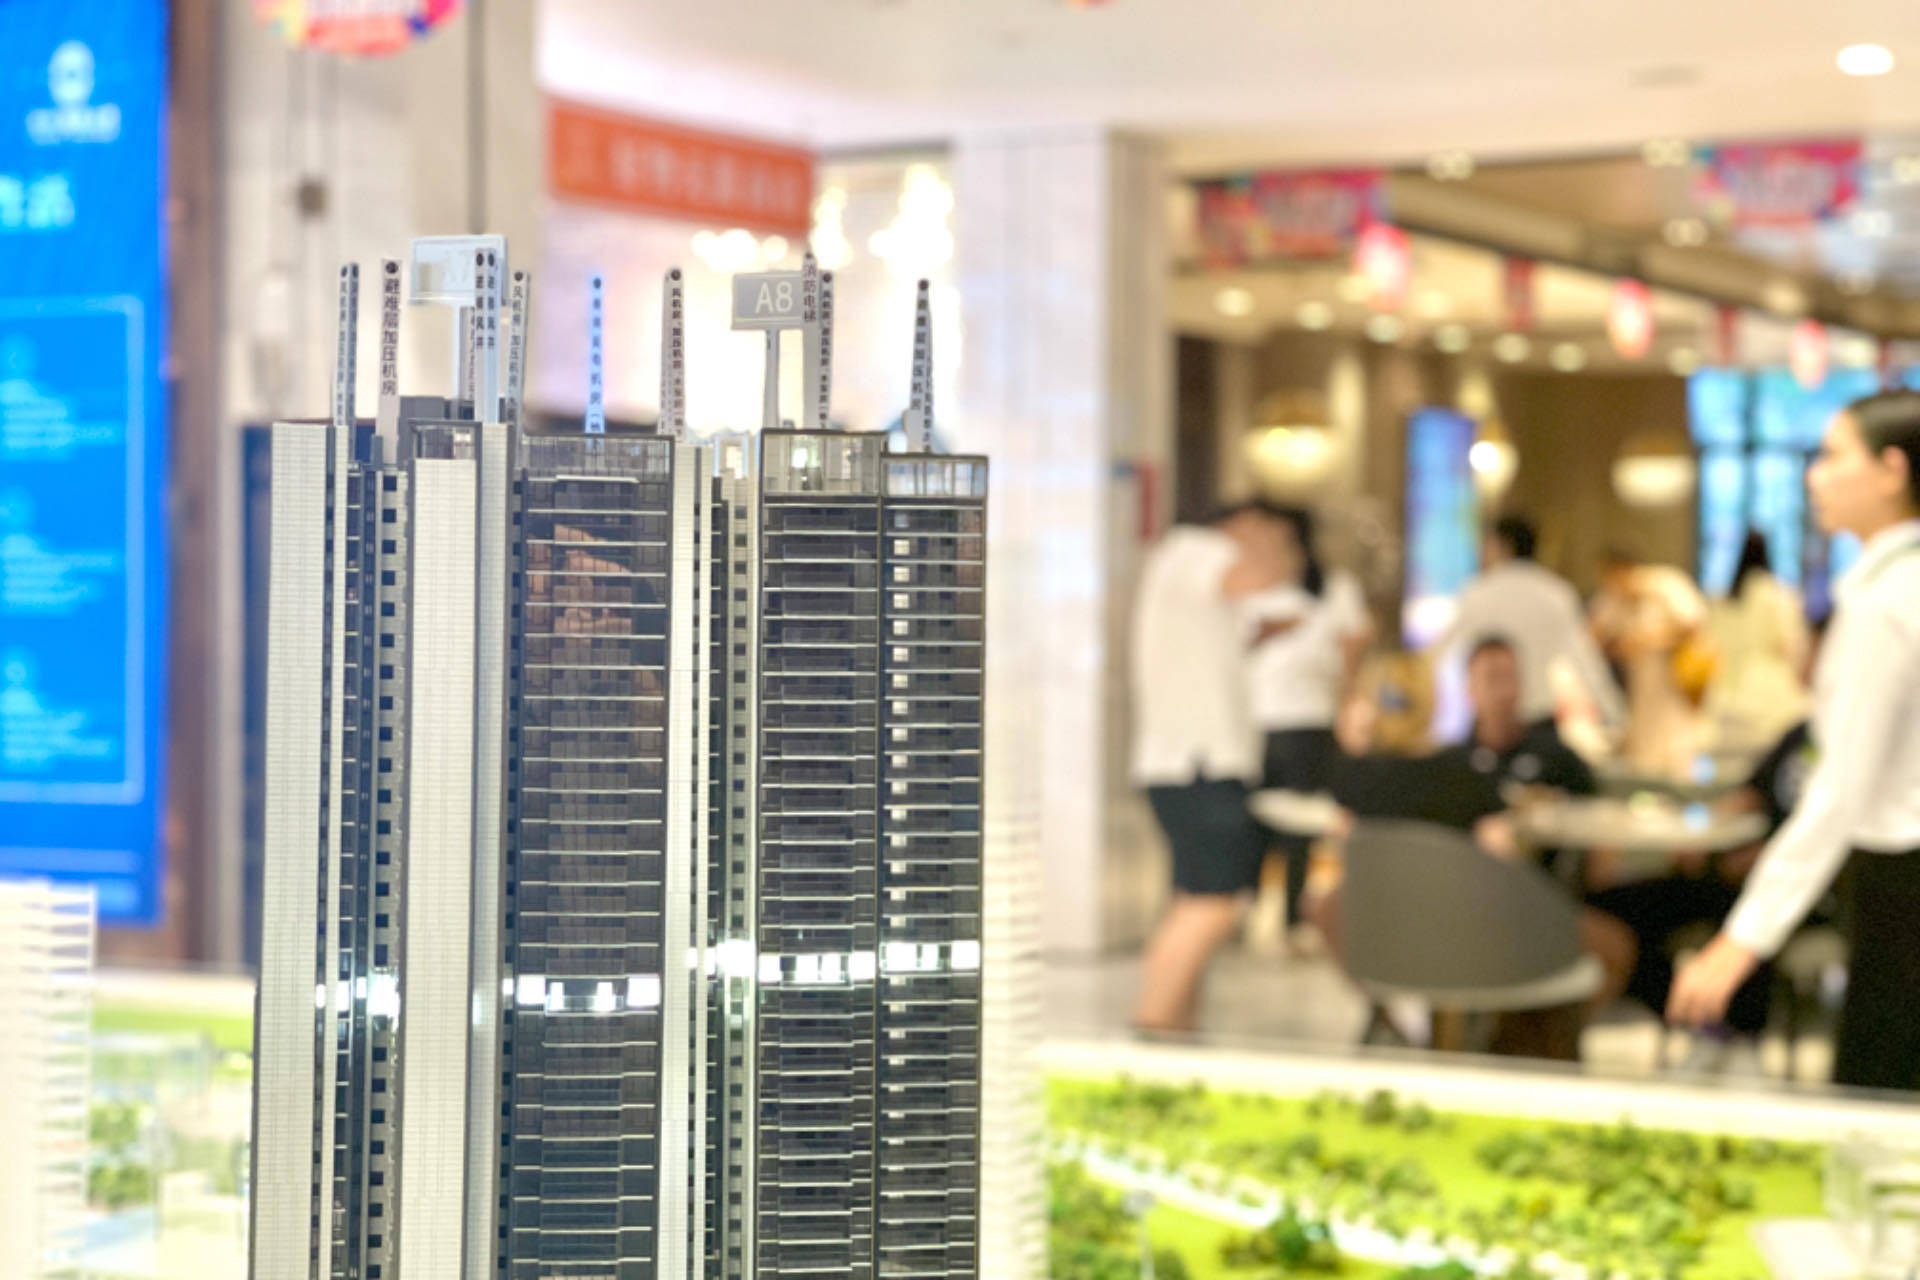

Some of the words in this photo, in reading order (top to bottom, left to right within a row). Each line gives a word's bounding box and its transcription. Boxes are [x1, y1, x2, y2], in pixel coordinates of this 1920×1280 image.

[755, 281, 793, 314] A8
[803, 264, 817, 321] 消防电梯
[382, 278, 400, 396] 避难层加压机房
